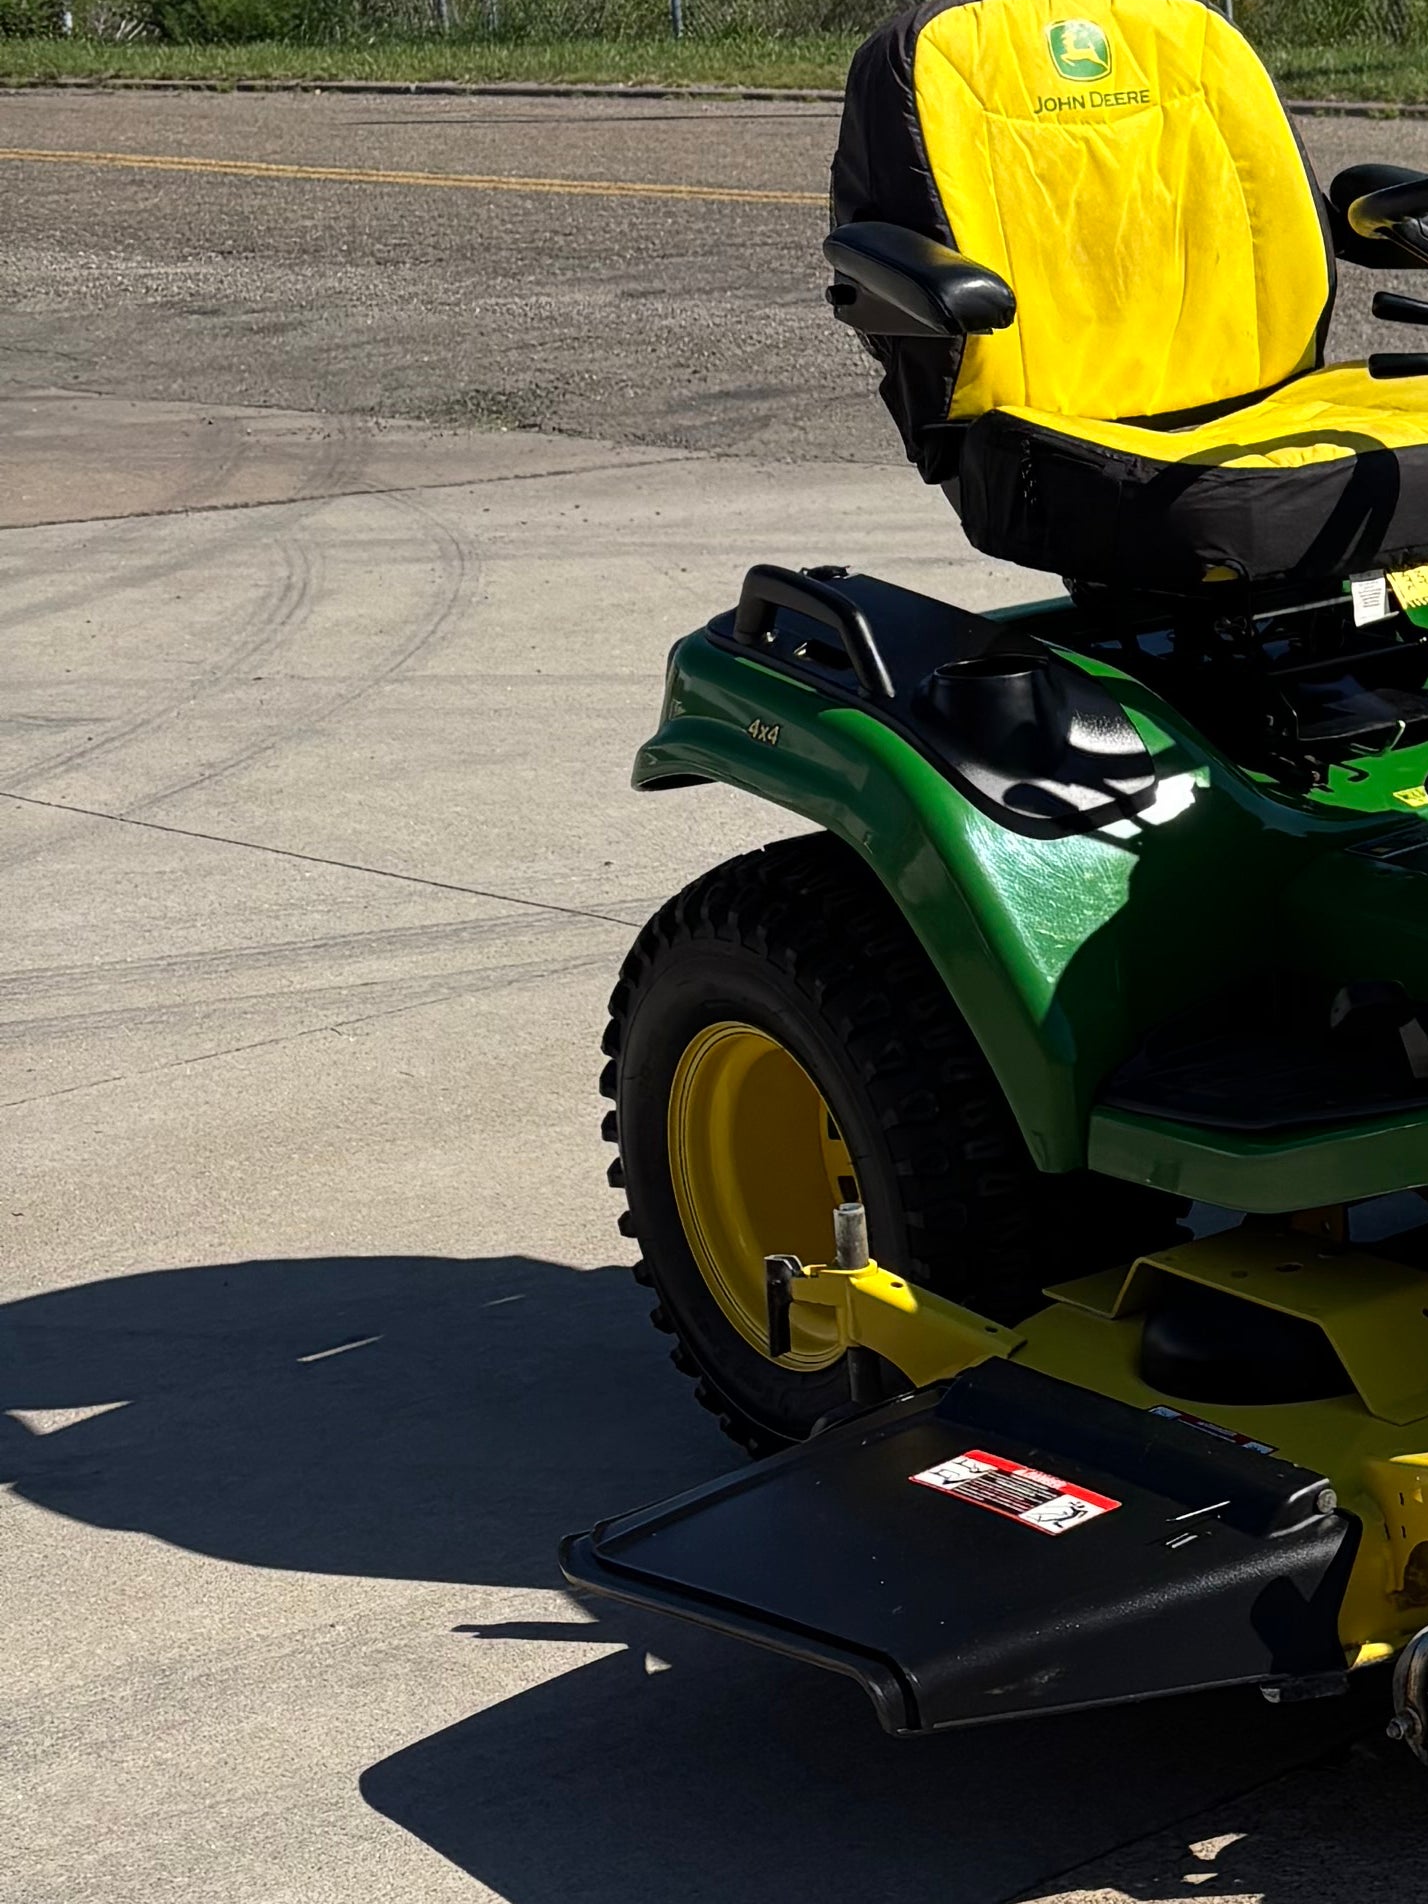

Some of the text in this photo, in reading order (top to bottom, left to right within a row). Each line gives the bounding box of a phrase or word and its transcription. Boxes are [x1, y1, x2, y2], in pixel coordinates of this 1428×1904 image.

[1034, 89, 1150, 114] JOHN DEERE
[747, 718, 780, 745] 4x4
